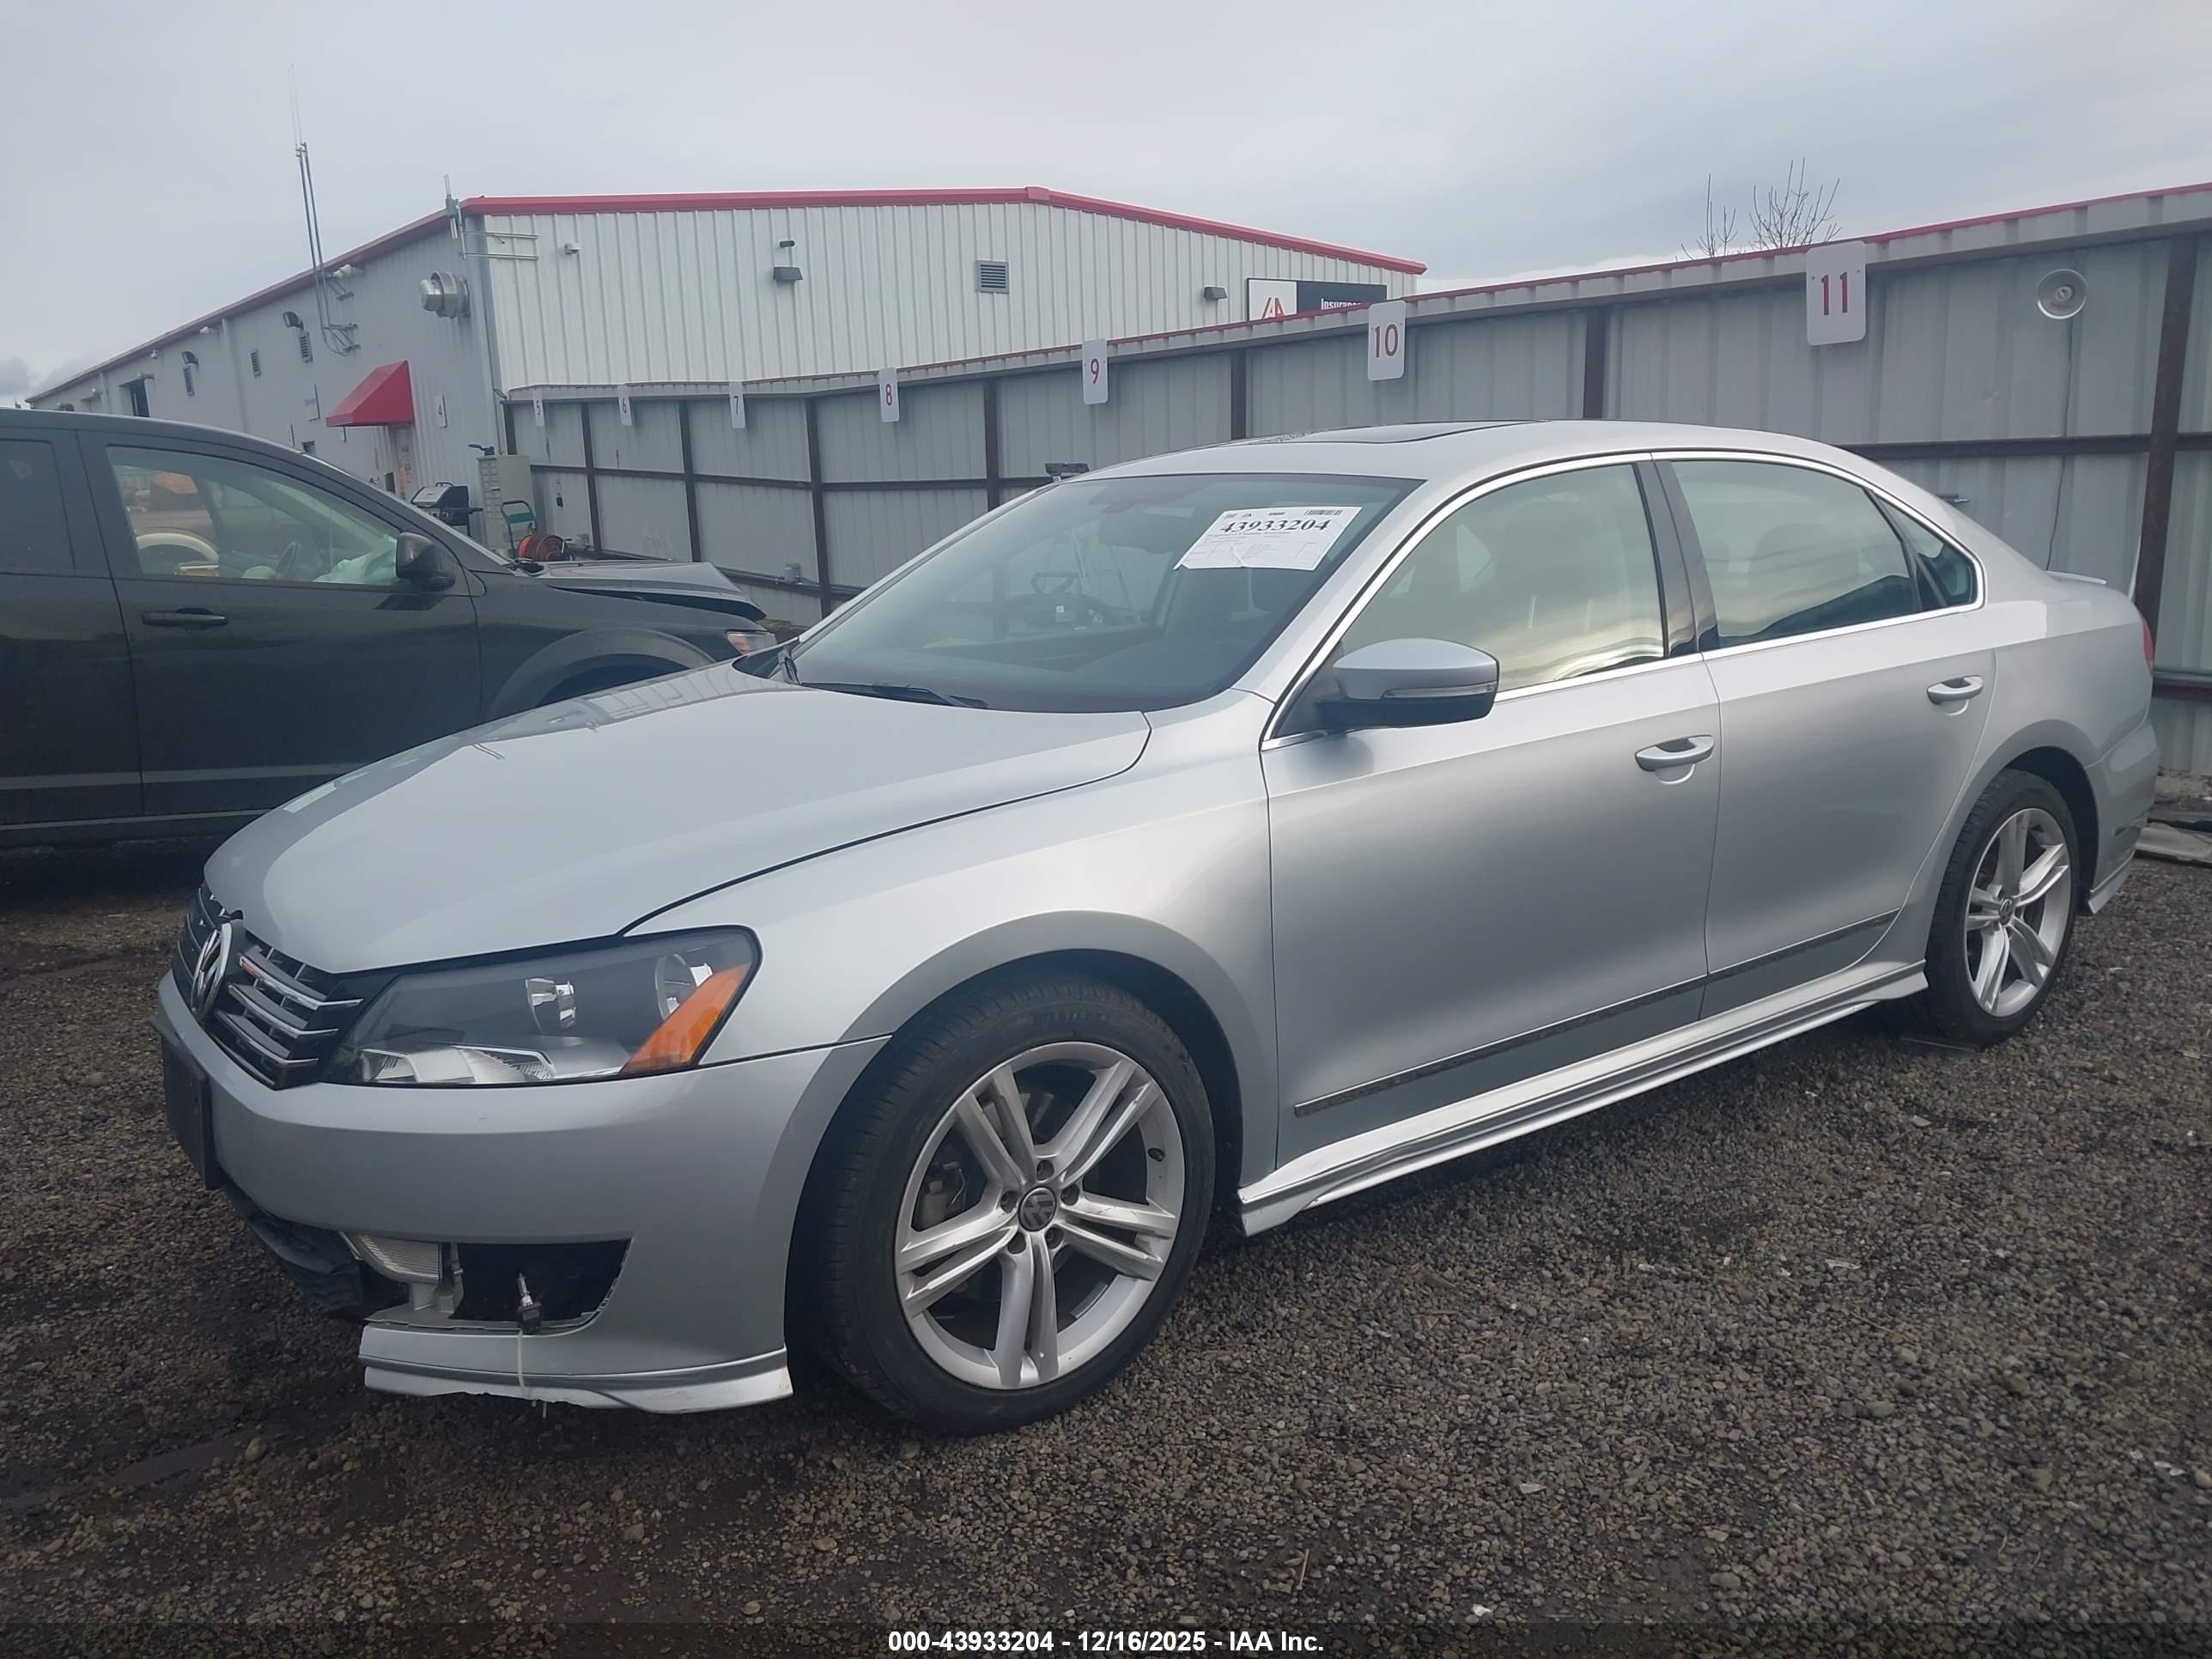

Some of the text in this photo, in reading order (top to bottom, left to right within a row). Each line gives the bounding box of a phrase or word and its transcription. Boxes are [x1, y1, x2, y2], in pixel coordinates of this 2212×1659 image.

[1820, 271, 1848, 316] 11
[1374, 323, 1399, 358] 10
[1090, 357, 1100, 385] 9
[733, 395, 739, 416] 7
[884, 383, 893, 406] 8
[536, 399, 542, 416] 5
[622, 398, 628, 414] 6
[1220, 519, 1331, 533] 43933204
